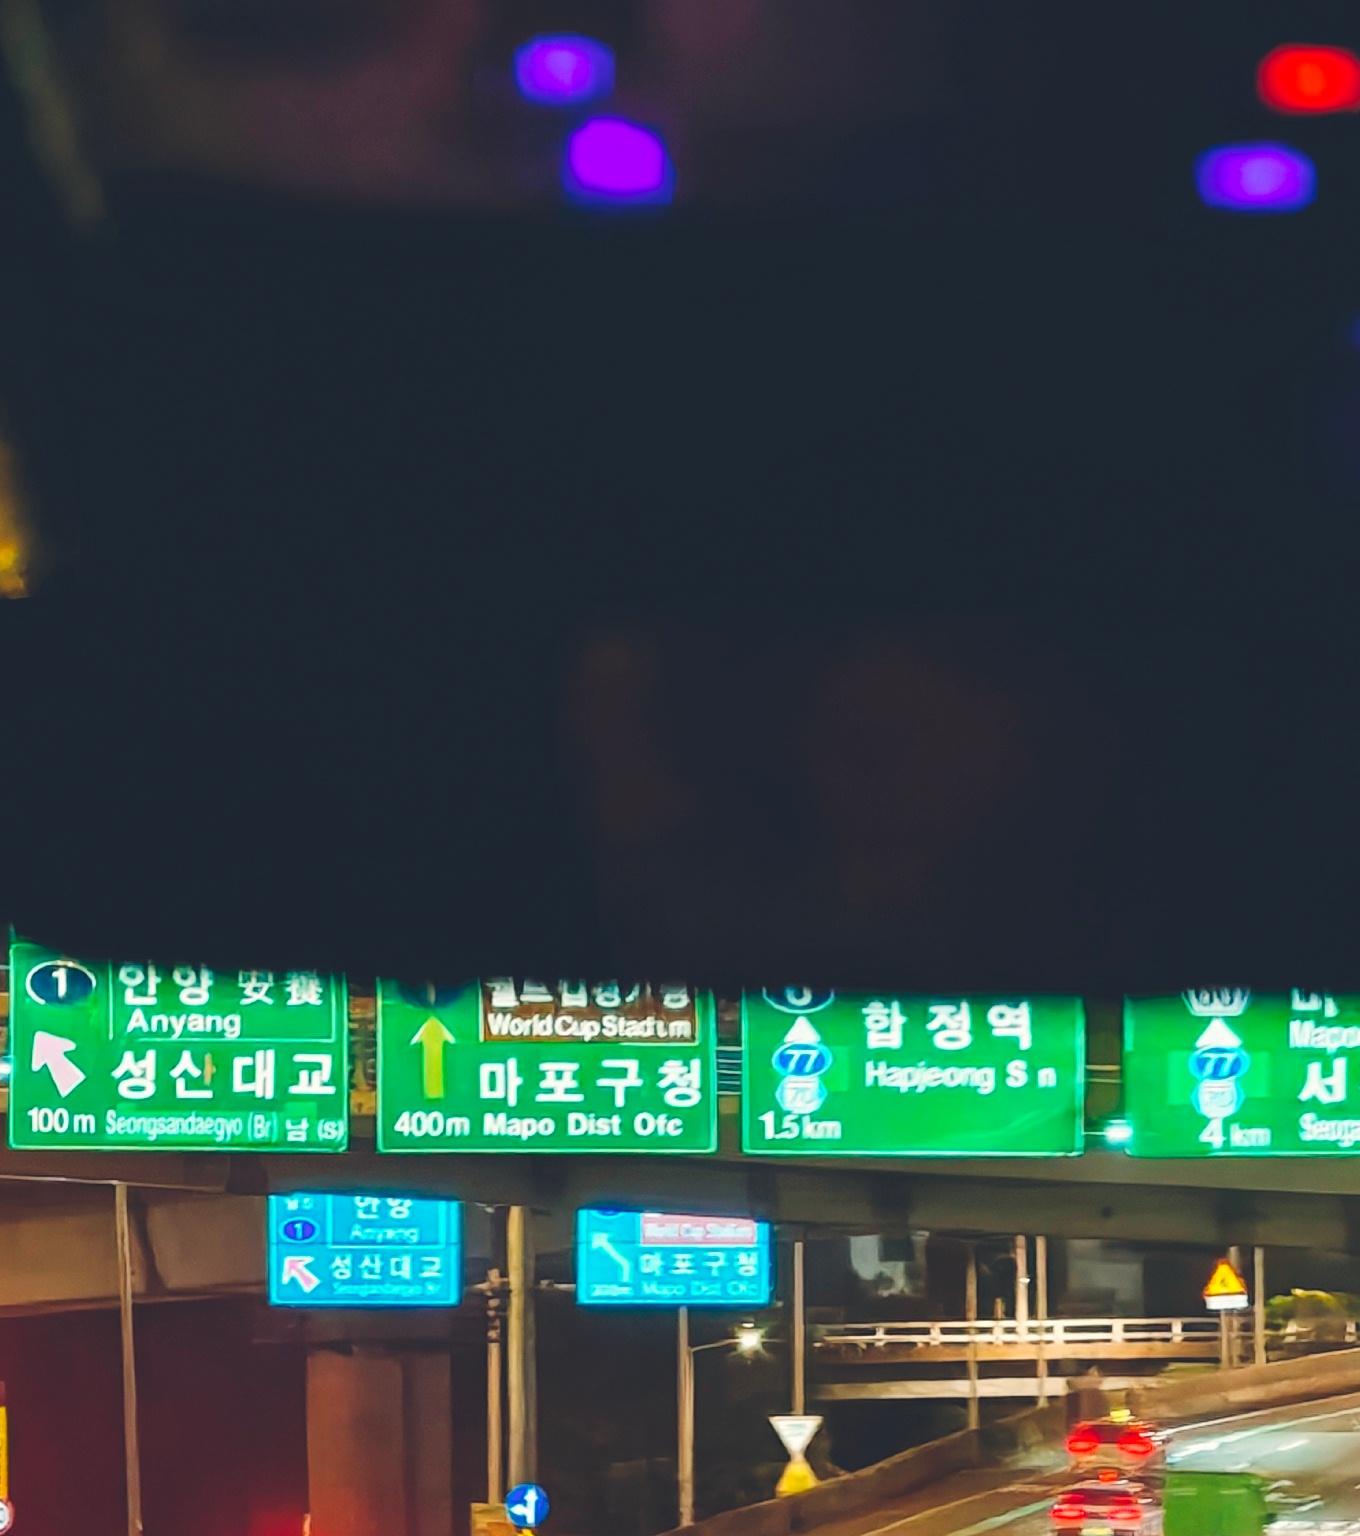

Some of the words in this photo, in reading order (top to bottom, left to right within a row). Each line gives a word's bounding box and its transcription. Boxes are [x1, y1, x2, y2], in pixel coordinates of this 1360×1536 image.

[52, 969, 68, 999] 1
[119, 962, 213, 1006] 안양
[126, 1008, 241, 1039] Anyang
[488, 1012, 553, 1037] World
[554, 1014, 600, 1042] Cup
[862, 1000, 1032, 1050] 합정역
[111, 1049, 336, 1099] 성산대교
[480, 1057, 702, 1107] 마포구청
[865, 1061, 995, 1094] Hapjeong
[28, 1107, 69, 1133] 100
[106, 1109, 242, 1142] Seongsandaegyo
[483, 1114, 555, 1140] Mapo
[568, 1112, 621, 1136] Dist
[633, 1111, 683, 1137] Ofc
[1198, 1117, 1226, 1149] 4
